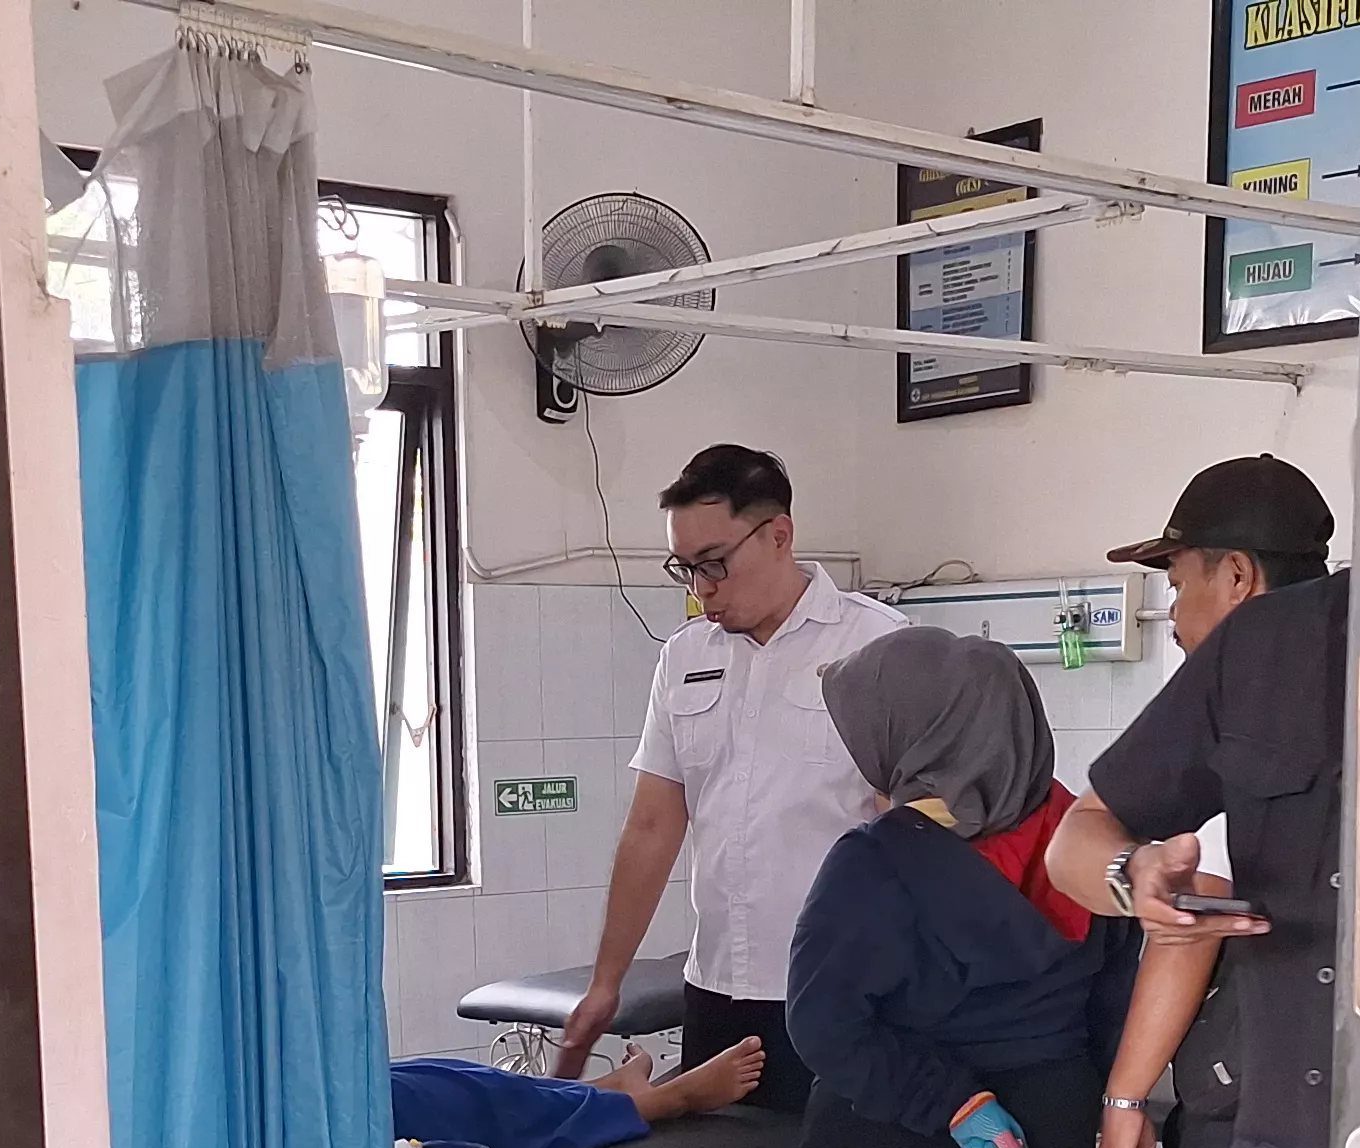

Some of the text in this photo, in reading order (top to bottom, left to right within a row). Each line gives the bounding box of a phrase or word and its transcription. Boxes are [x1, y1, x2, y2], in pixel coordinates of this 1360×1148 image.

[1249, 85, 1302, 114] MERAH
[1246, 259, 1293, 284] HIJAU
[1093, 610, 1119, 624] SANI
[542, 782, 567, 795] JALUR
[536, 797, 574, 810] EVAKUASI
